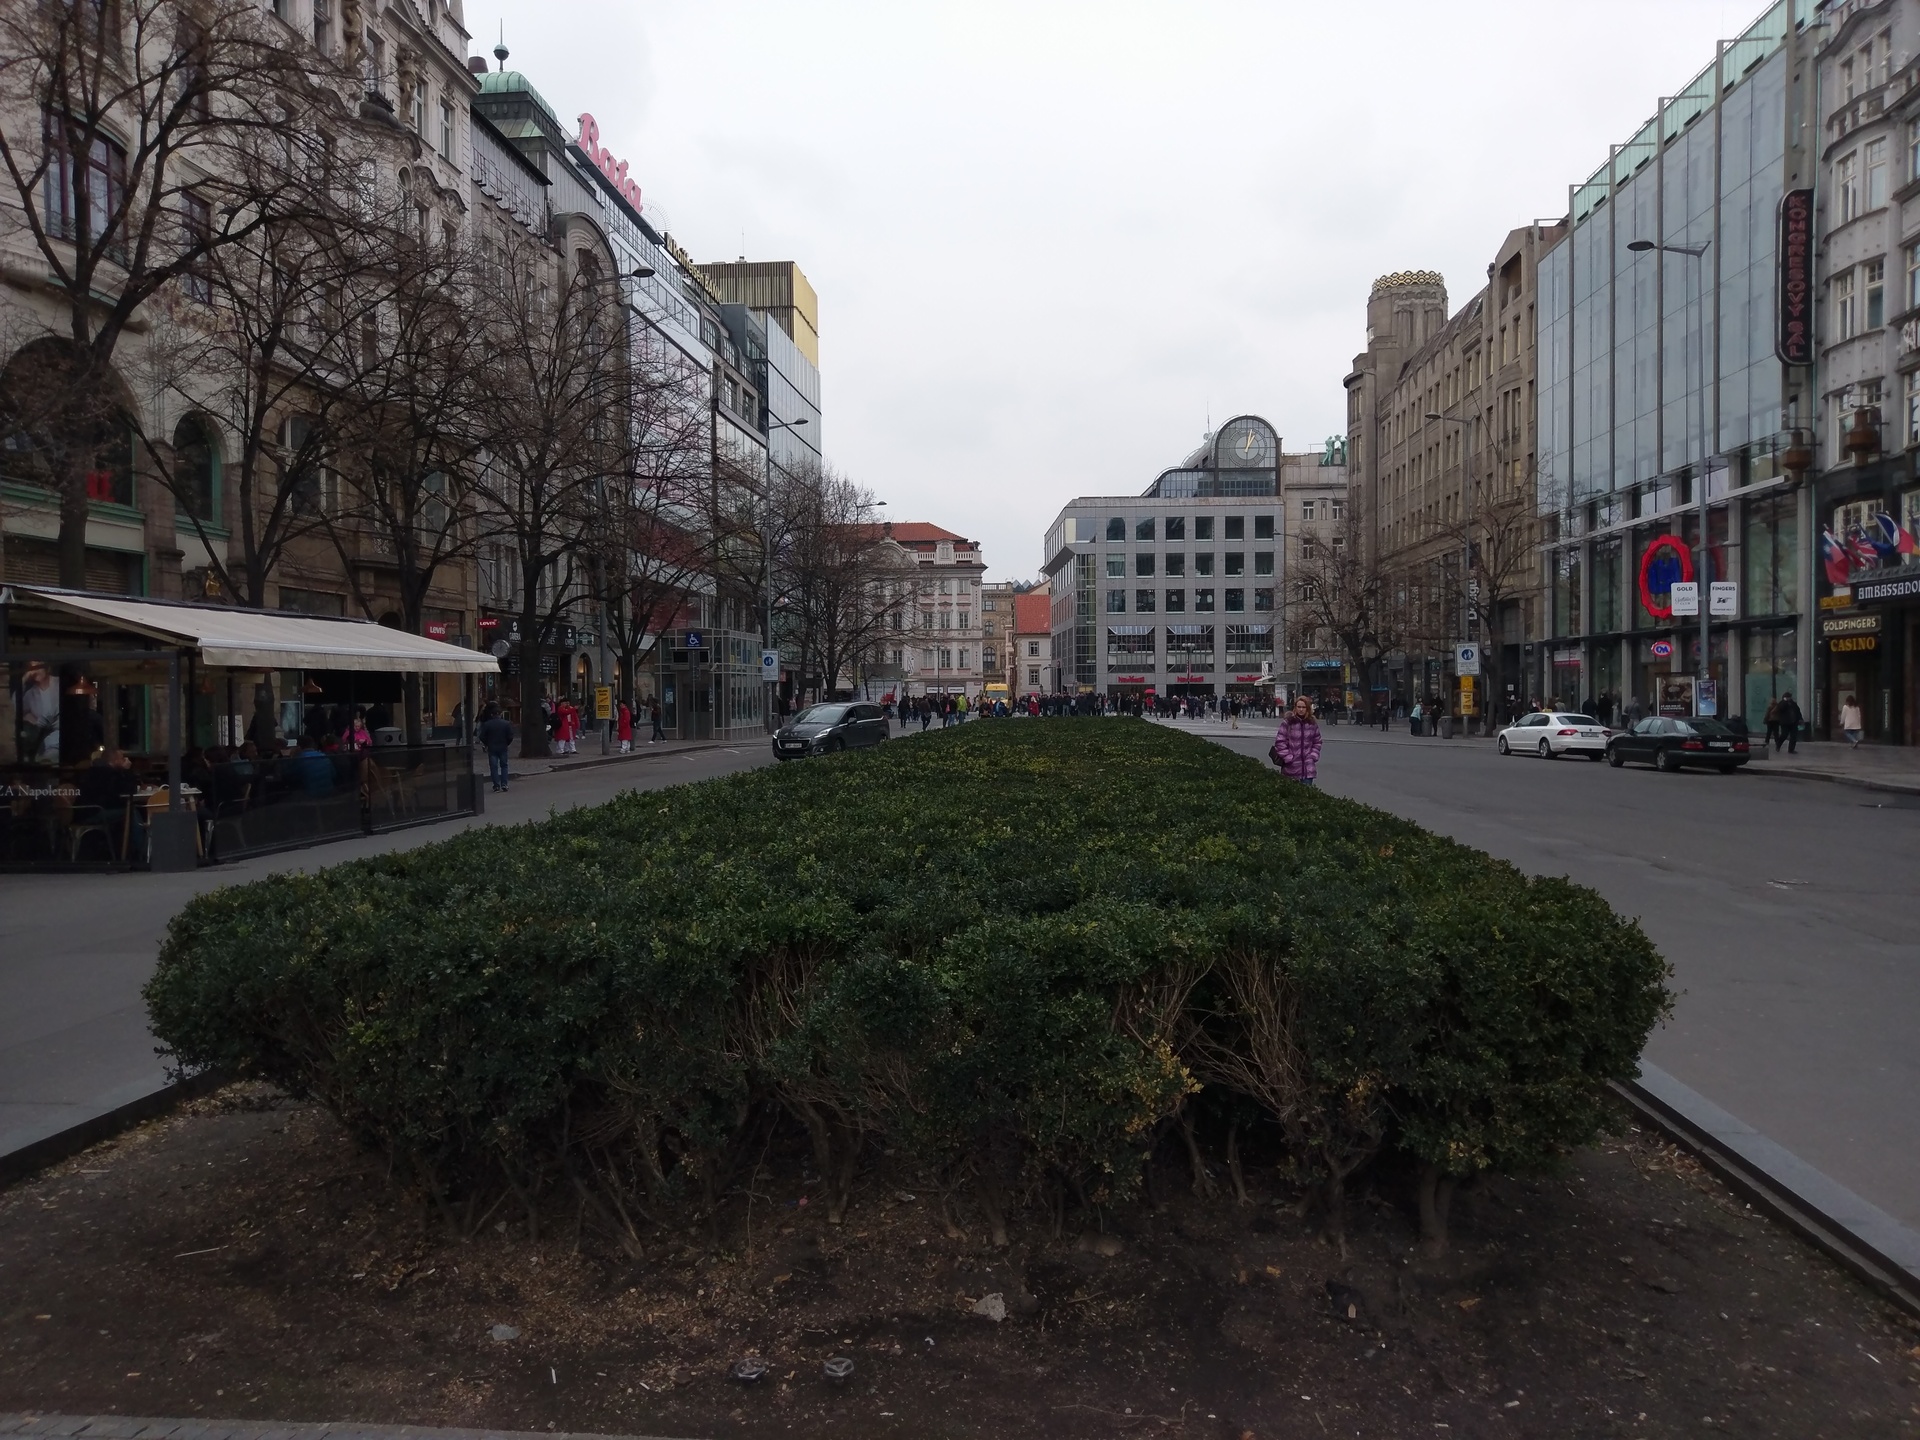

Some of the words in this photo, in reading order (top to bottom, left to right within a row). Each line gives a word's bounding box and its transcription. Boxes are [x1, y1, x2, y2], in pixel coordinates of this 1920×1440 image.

[1858, 579, 1920, 600] AMBASSADO
[1823, 617, 1876, 632] GOLDFINGERS
[1830, 636, 1876, 653] CASINO
[18, 784, 81, 801] Napoletana
